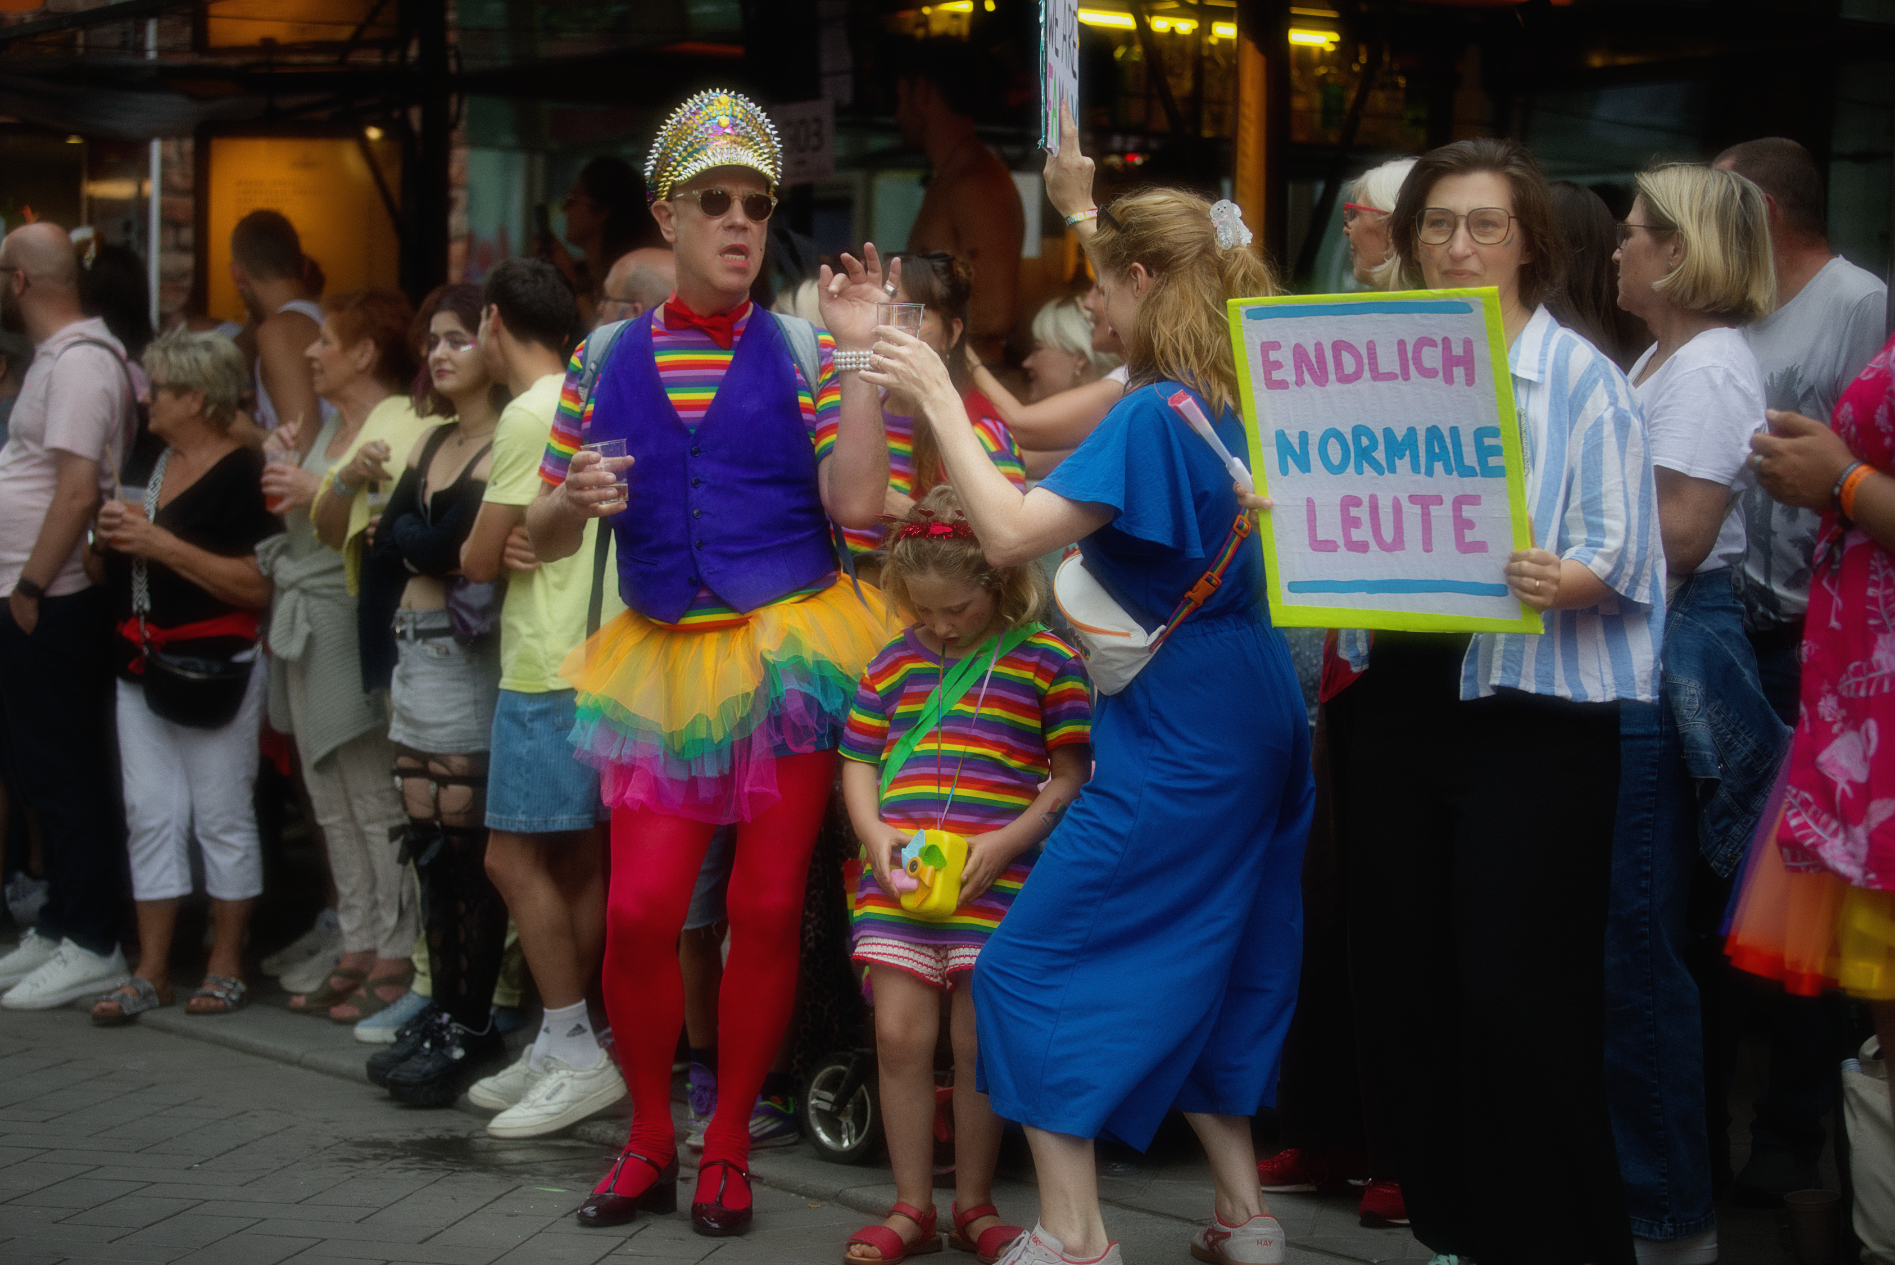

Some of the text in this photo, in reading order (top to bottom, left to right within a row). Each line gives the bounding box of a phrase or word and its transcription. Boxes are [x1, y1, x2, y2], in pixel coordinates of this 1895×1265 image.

[1047, 0, 1078, 80] WE ARE
[1260, 336, 1475, 390] ENDLICH
[1275, 424, 1507, 478] NORMALE
[1306, 493, 1489, 554] LEUTE
